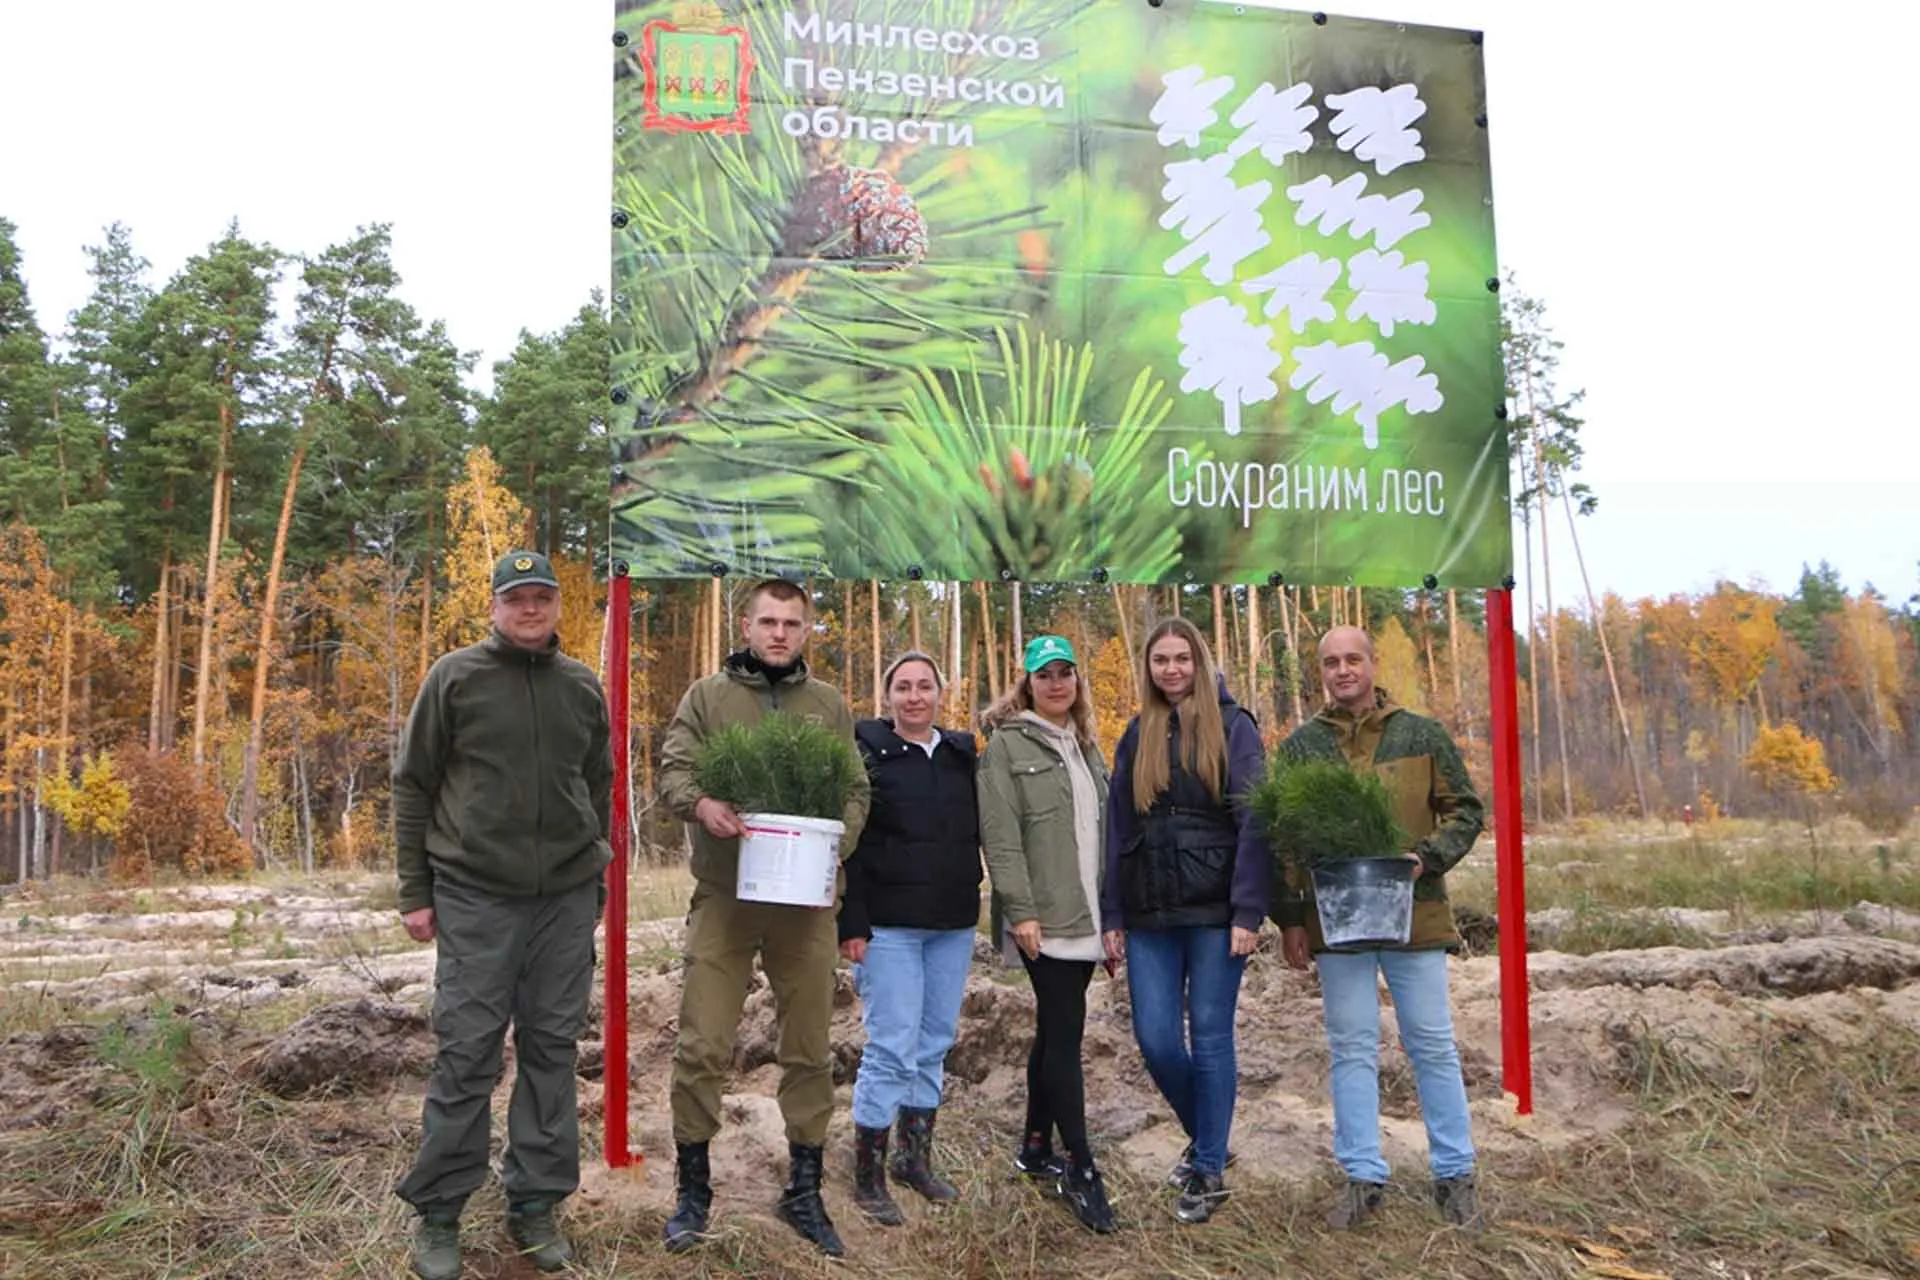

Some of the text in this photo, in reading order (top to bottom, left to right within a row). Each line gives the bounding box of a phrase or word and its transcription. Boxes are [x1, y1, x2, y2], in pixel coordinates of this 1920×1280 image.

[783, 12, 1040, 58] Минлесхоз
[783, 59, 1064, 108] Пензенской
[782, 108, 973, 146] области
[1168, 448, 1444, 528] Сохраним лес
